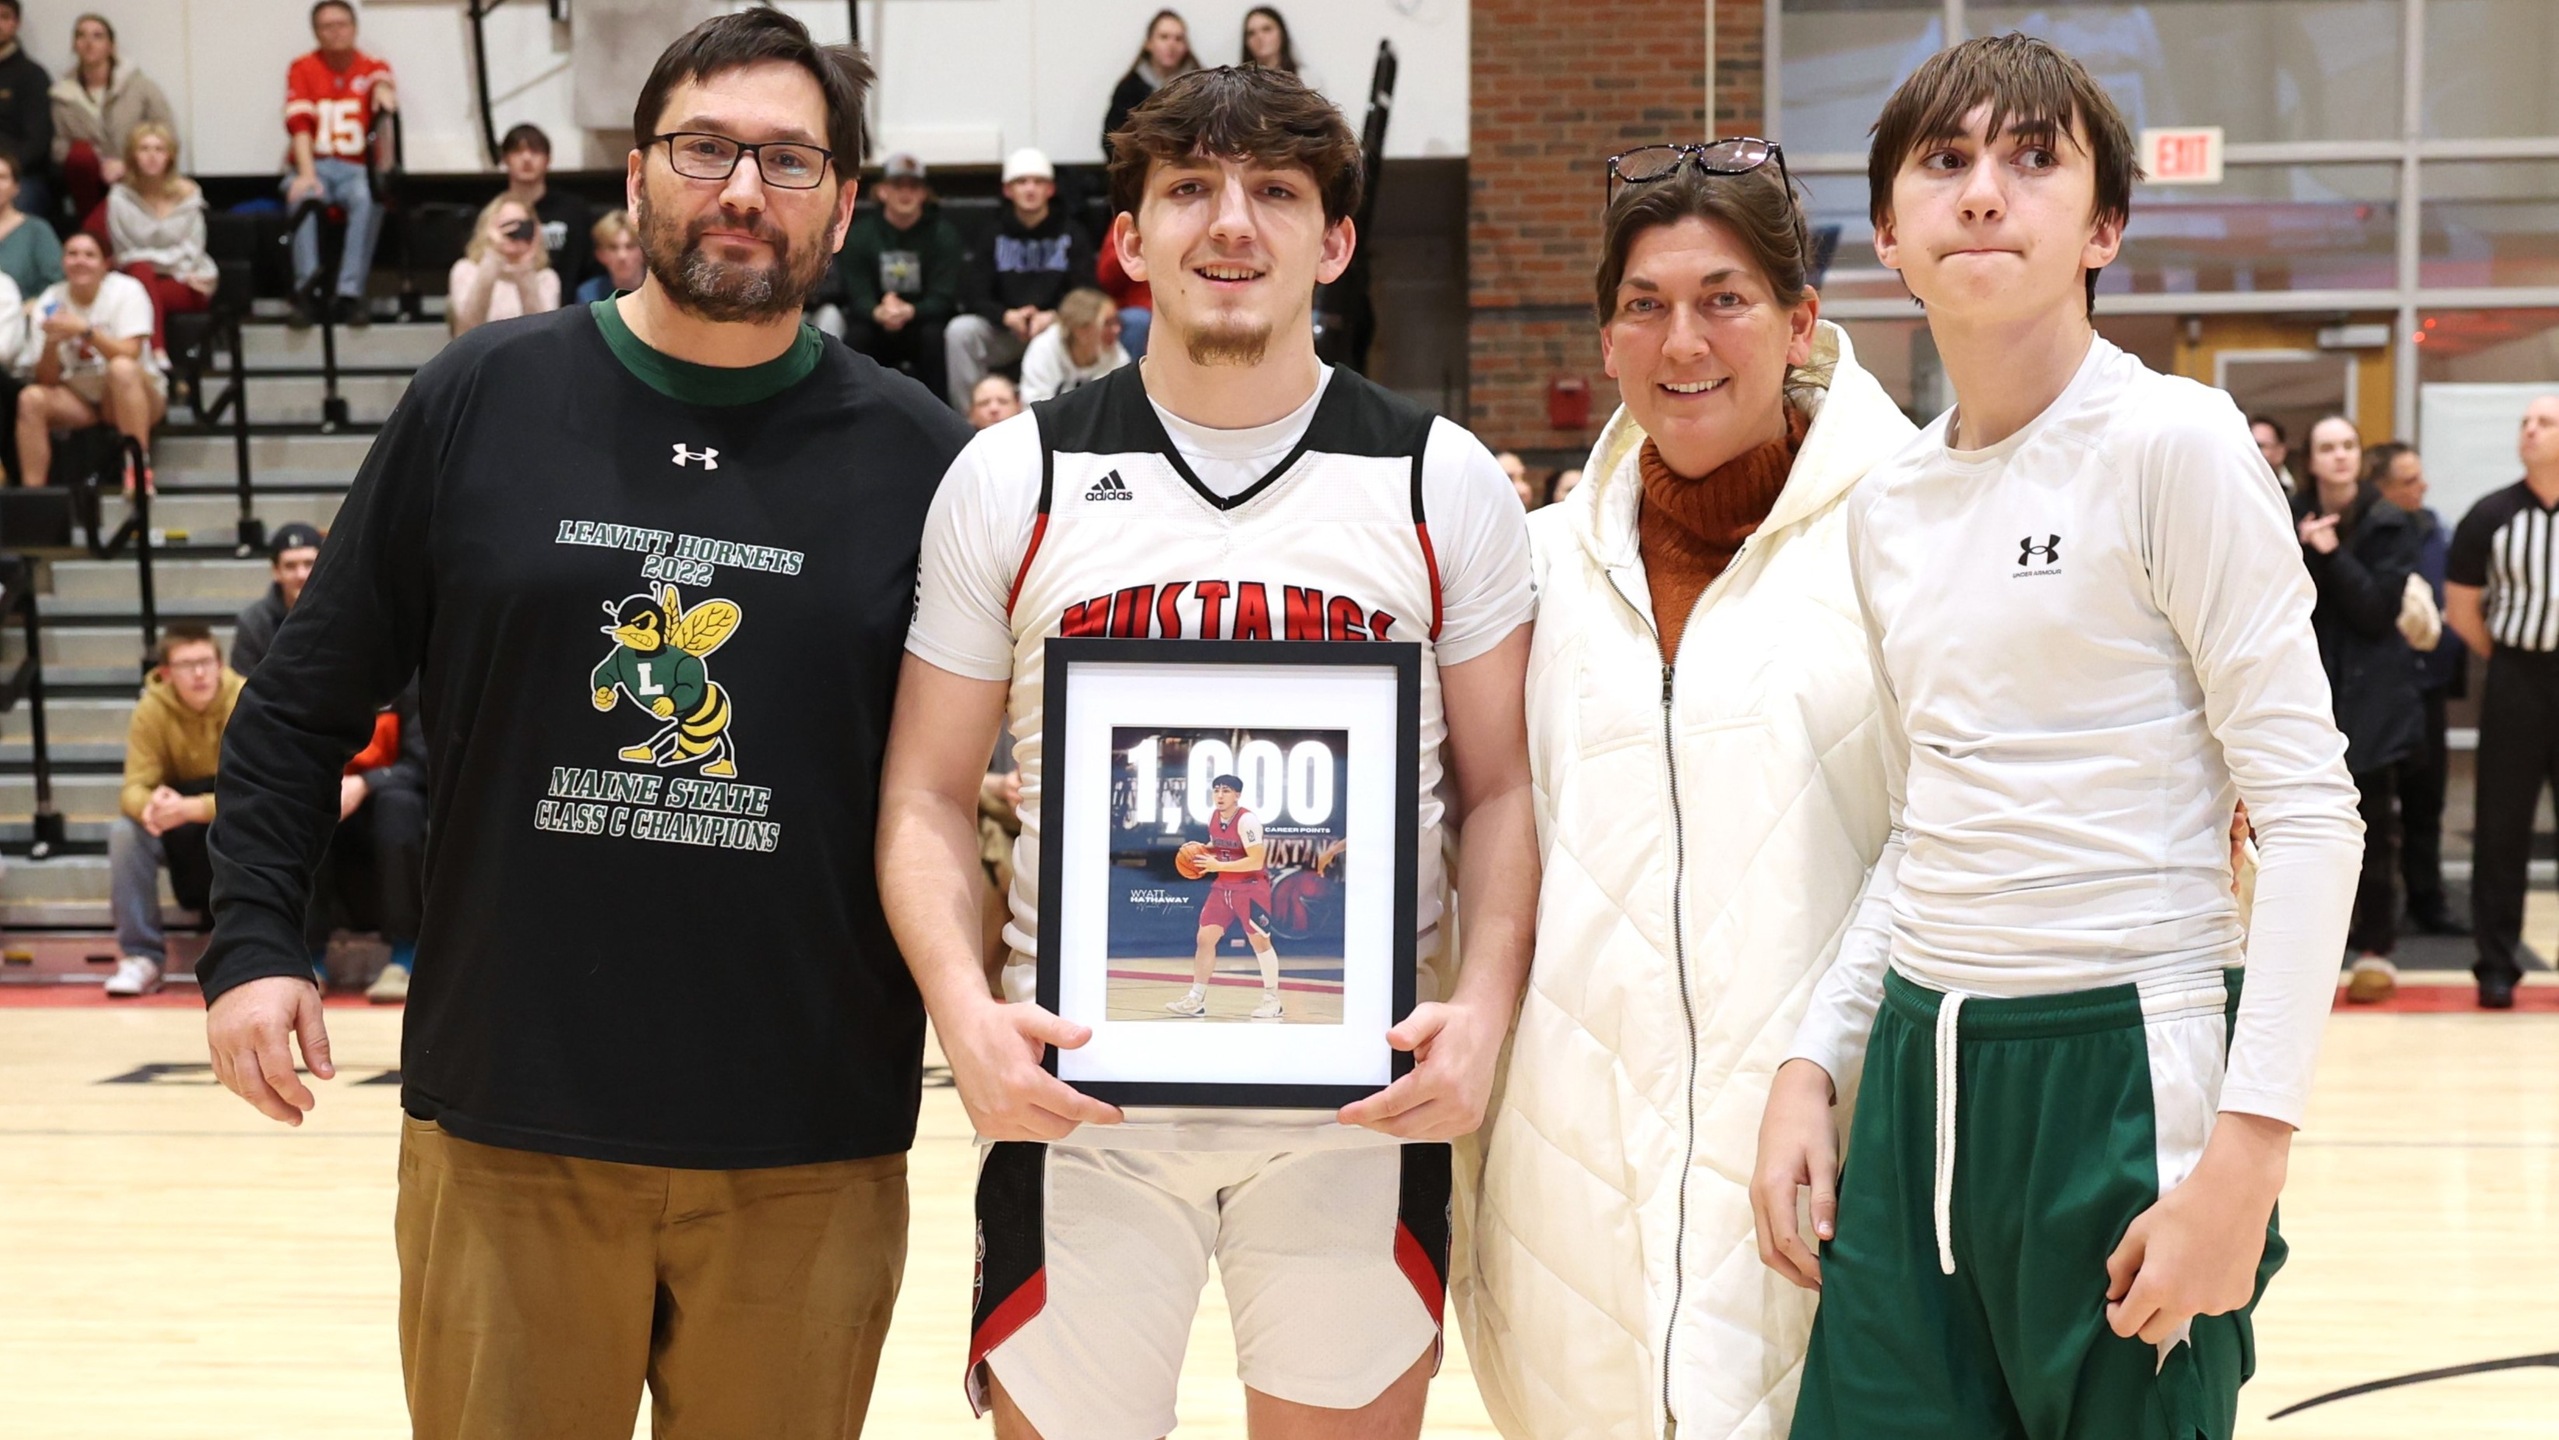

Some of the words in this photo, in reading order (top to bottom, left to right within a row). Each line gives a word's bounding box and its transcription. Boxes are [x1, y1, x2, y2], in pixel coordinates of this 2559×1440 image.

[315, 98, 365, 155] 15
[2156, 134, 2207, 178] EXIT
[1085, 489, 1133, 501] adidas
[555, 519, 673, 555] LEAVITT
[674, 534, 805, 576] HORNETS
[641, 555, 714, 587] 2022
[637, 662, 664, 696] L
[548, 766, 662, 805] MAINE
[666, 778, 771, 816] STATE
[1128, 734, 1334, 834] 1,000
[534, 800, 605, 835] CLASS
[611, 808, 630, 837] C
[631, 810, 781, 852] CHAMPIONS
[1130, 889, 1165, 898] WYATT
[1130, 896, 1189, 904] HATHAWAY
